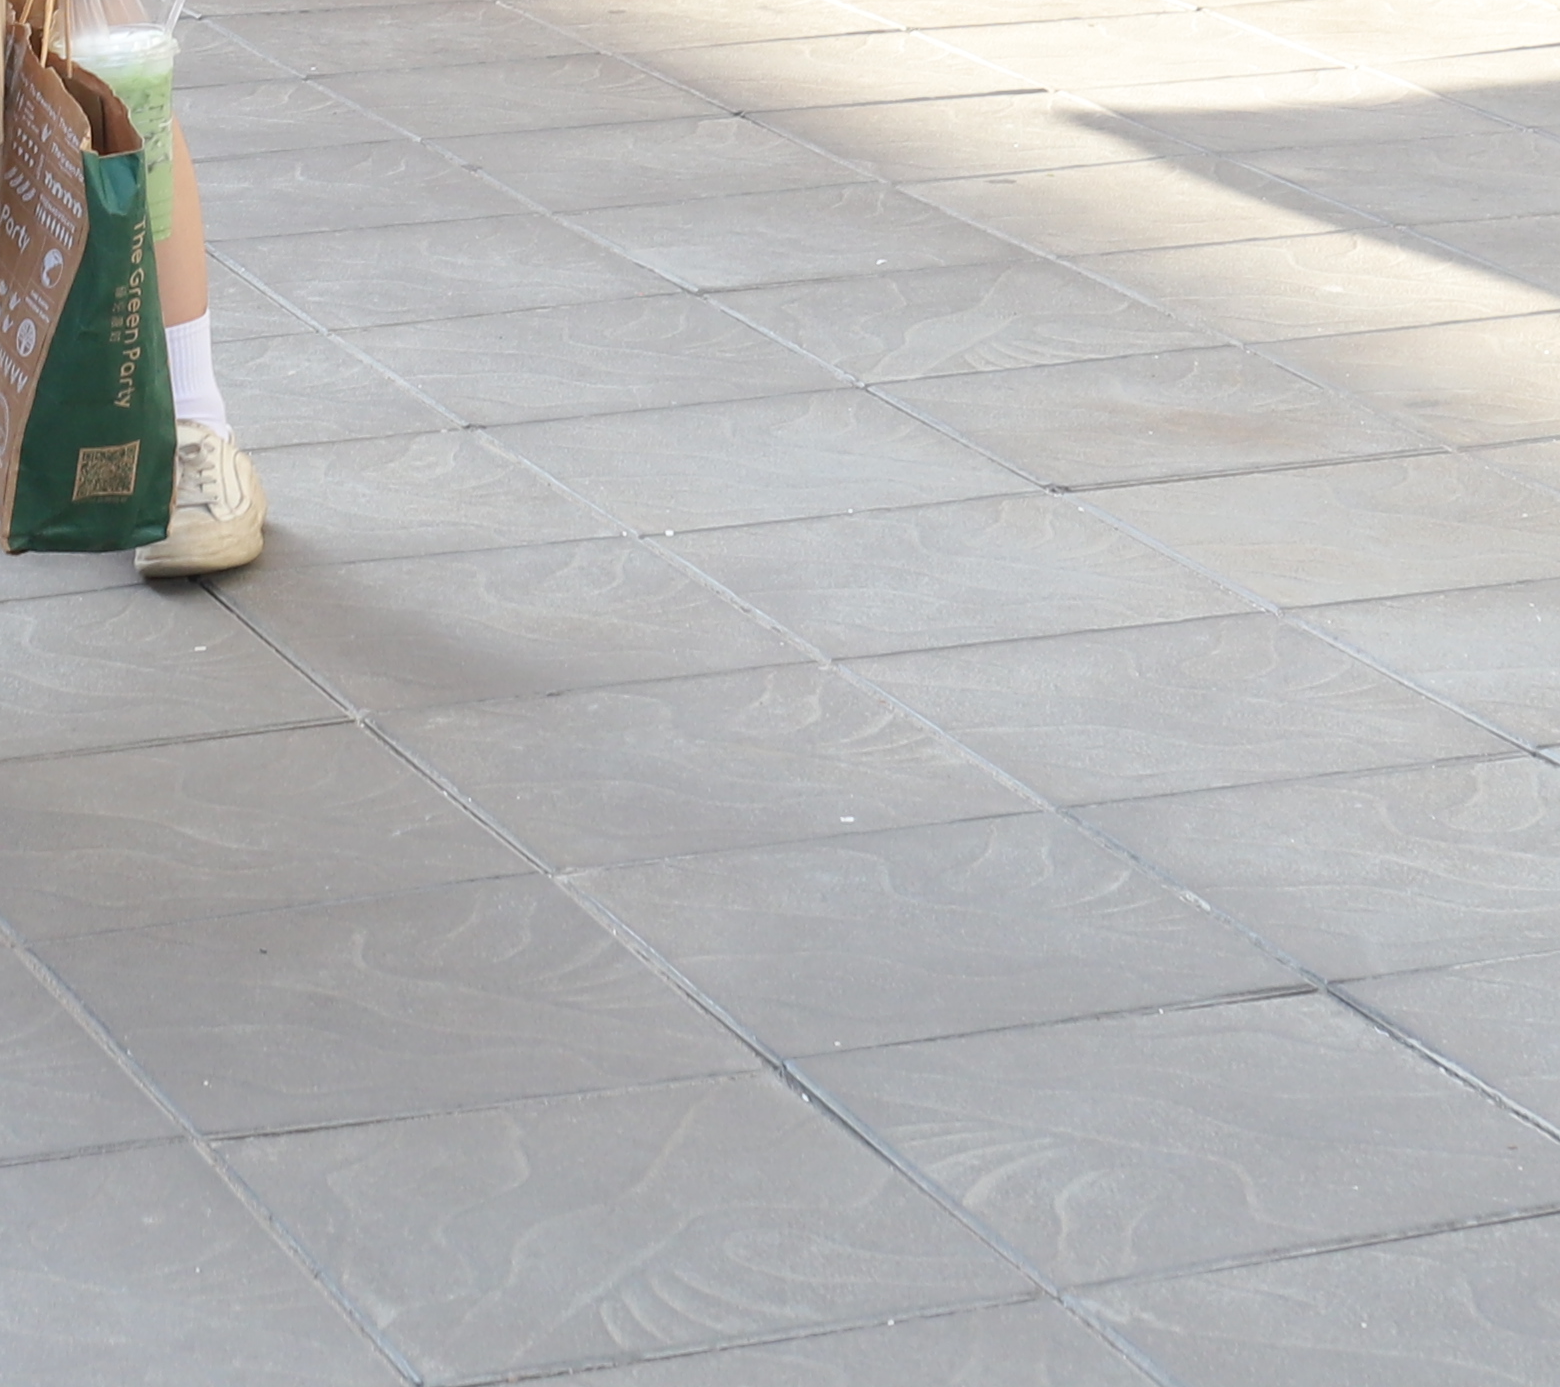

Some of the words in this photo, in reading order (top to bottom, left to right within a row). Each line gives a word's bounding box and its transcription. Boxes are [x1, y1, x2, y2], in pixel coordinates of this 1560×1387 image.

[0, 203, 31, 255] Party
[131, 217, 147, 265] The
[124, 267, 146, 345] Green
[114, 346, 142, 409] Party
